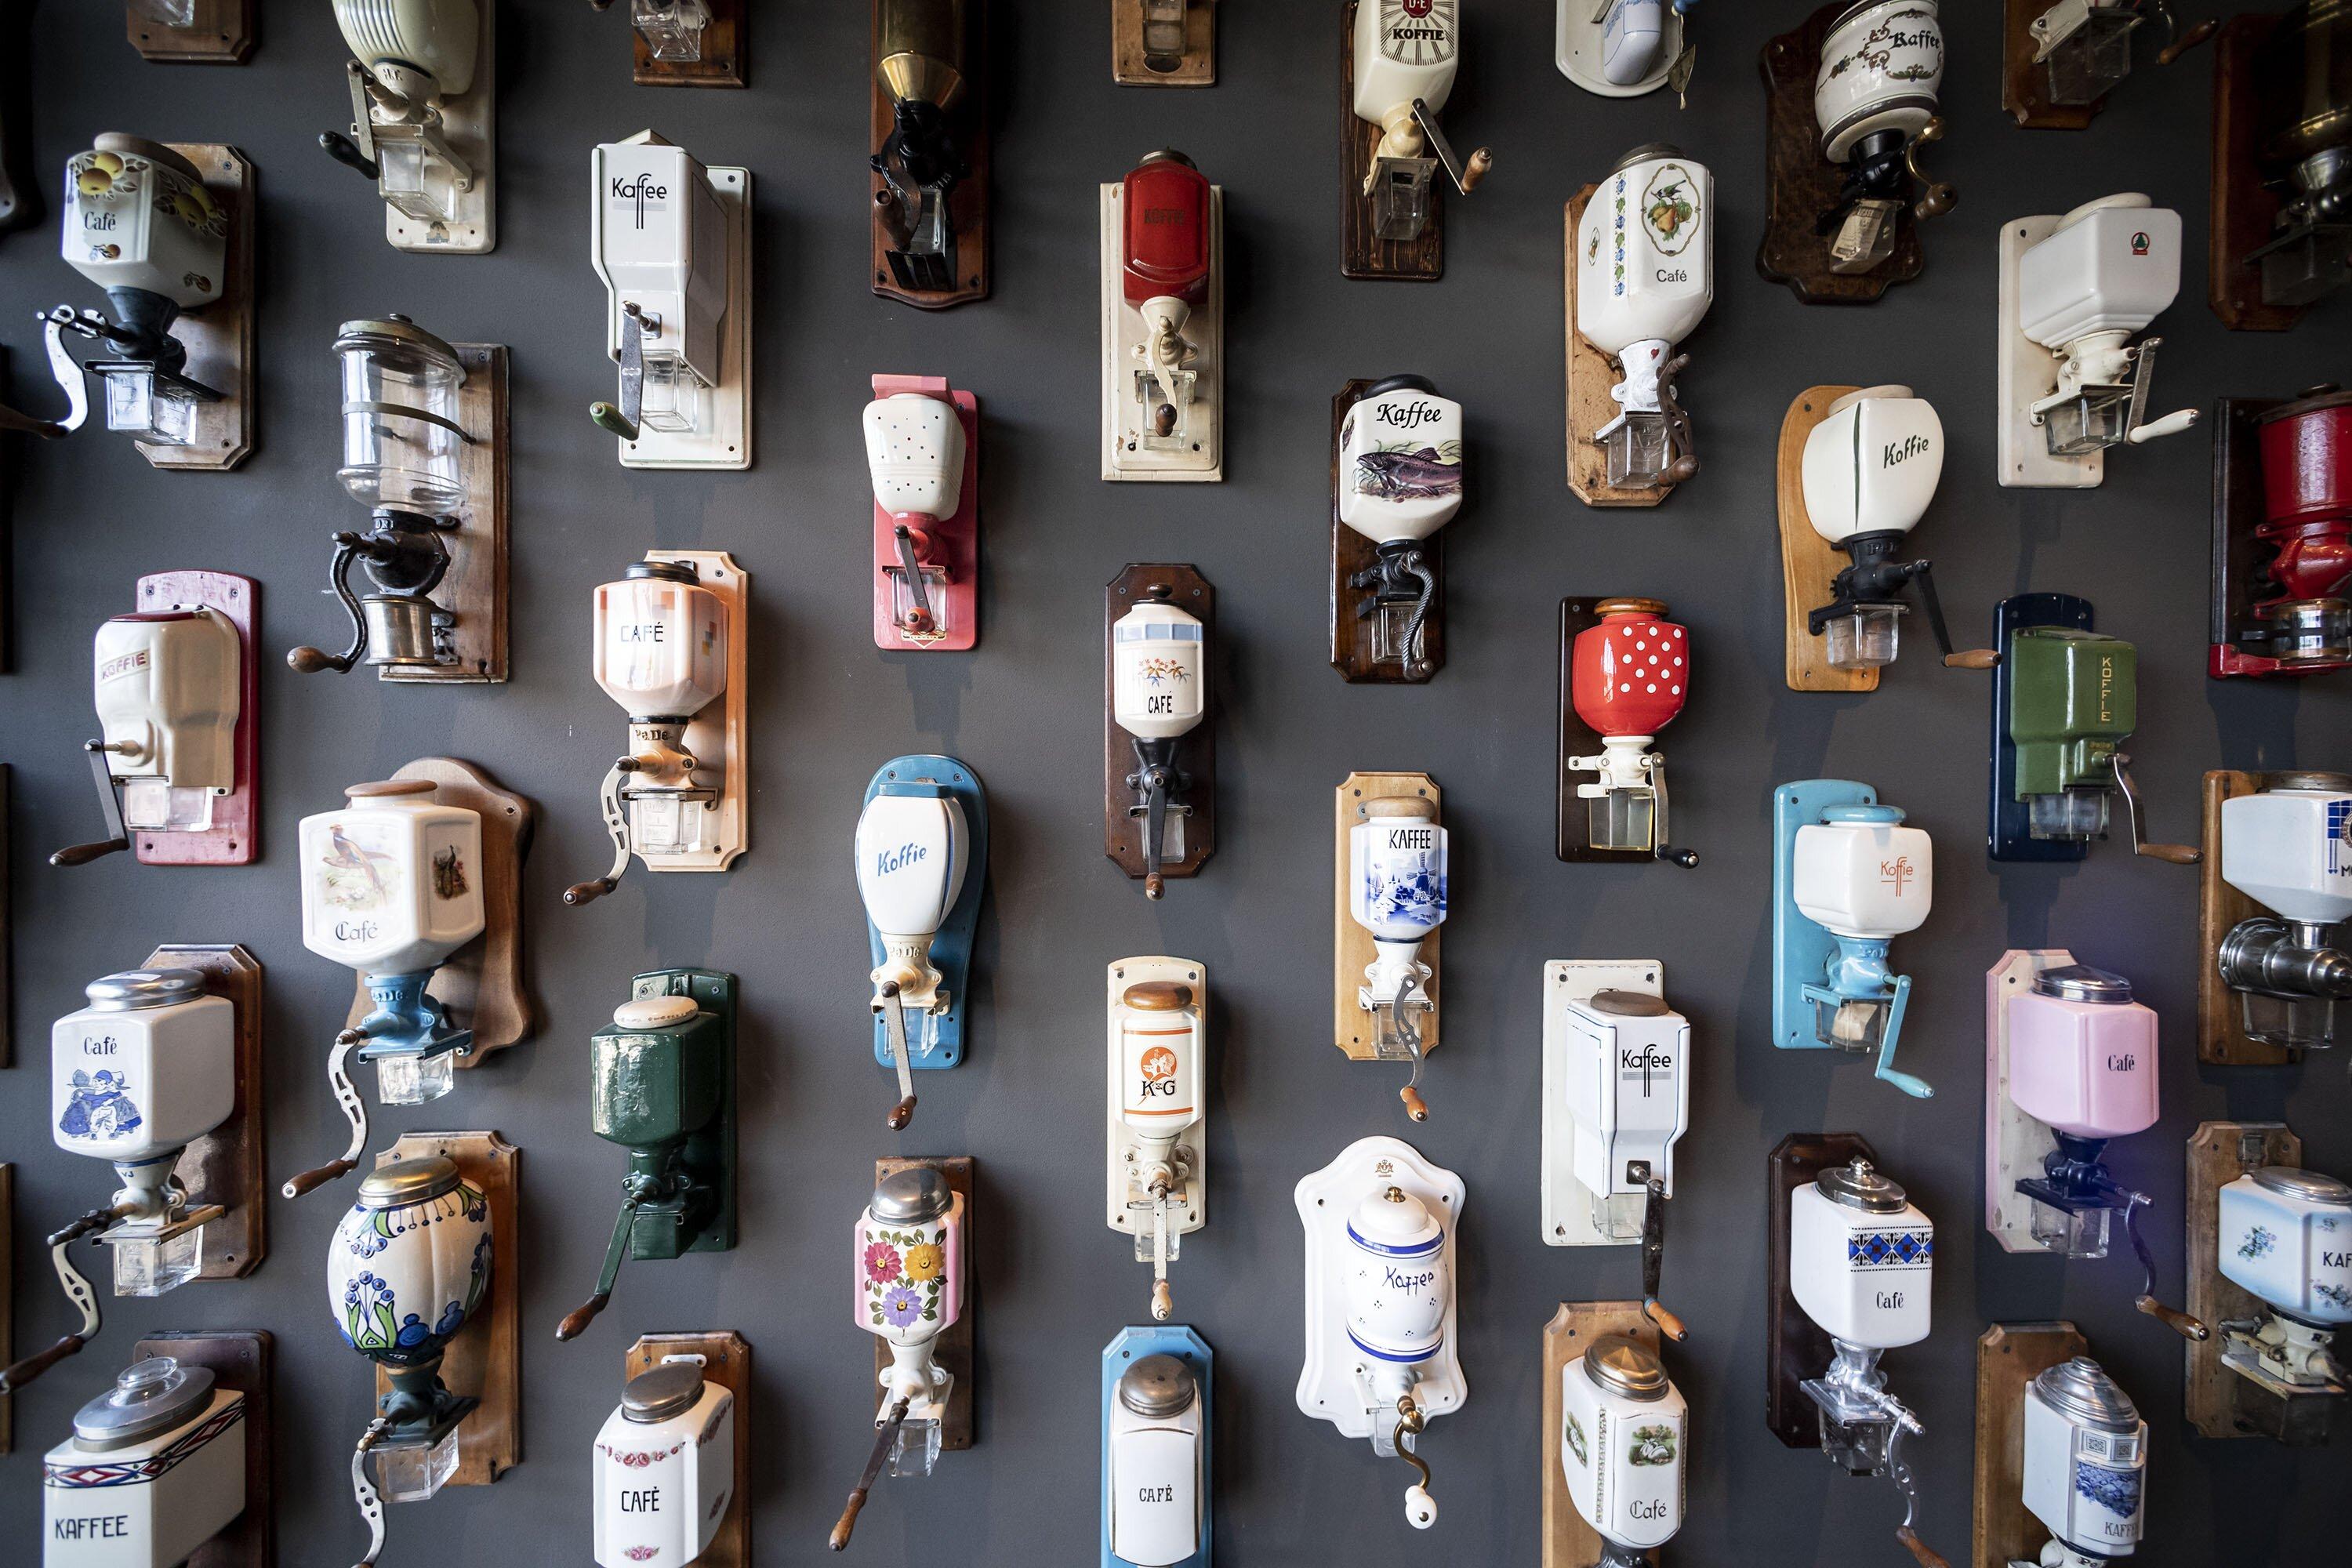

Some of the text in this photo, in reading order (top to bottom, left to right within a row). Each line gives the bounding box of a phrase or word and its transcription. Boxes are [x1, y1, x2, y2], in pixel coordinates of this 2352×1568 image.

[1392, 28, 1445, 41] KOFFIE
[1888, 30, 1940, 49] Kaffee
[612, 173, 667, 230] Kaffee
[85, 212, 116, 230] Café
[1657, 269, 1687, 282] Café
[1376, 401, 1442, 429] Kaffee
[1884, 434, 1929, 469] Koffie
[621, 621, 663, 642] CAFÉ
[102, 652, 147, 680] KOFFIE
[2101, 657, 2112, 721] KOFFIE
[1148, 690, 1173, 713] CAFÉ
[1389, 829, 1431, 849] KAFFEE
[878, 842, 927, 877] Koffie
[1881, 856, 1914, 897] Koffie
[336, 920, 378, 943] Café
[84, 1036, 118, 1054] Café
[1622, 1044, 1671, 1098] Kaffee
[2108, 1054, 2135, 1072] Café
[1876, 1291, 1904, 1309] Café
[622, 1486, 660, 1512] CAFÉ
[1139, 1483, 1173, 1502] CAFÉ
[1630, 1498, 1667, 1520] Café
[55, 1515, 129, 1539] KAFFEE
[2105, 1521, 2138, 1537] KAFFE
